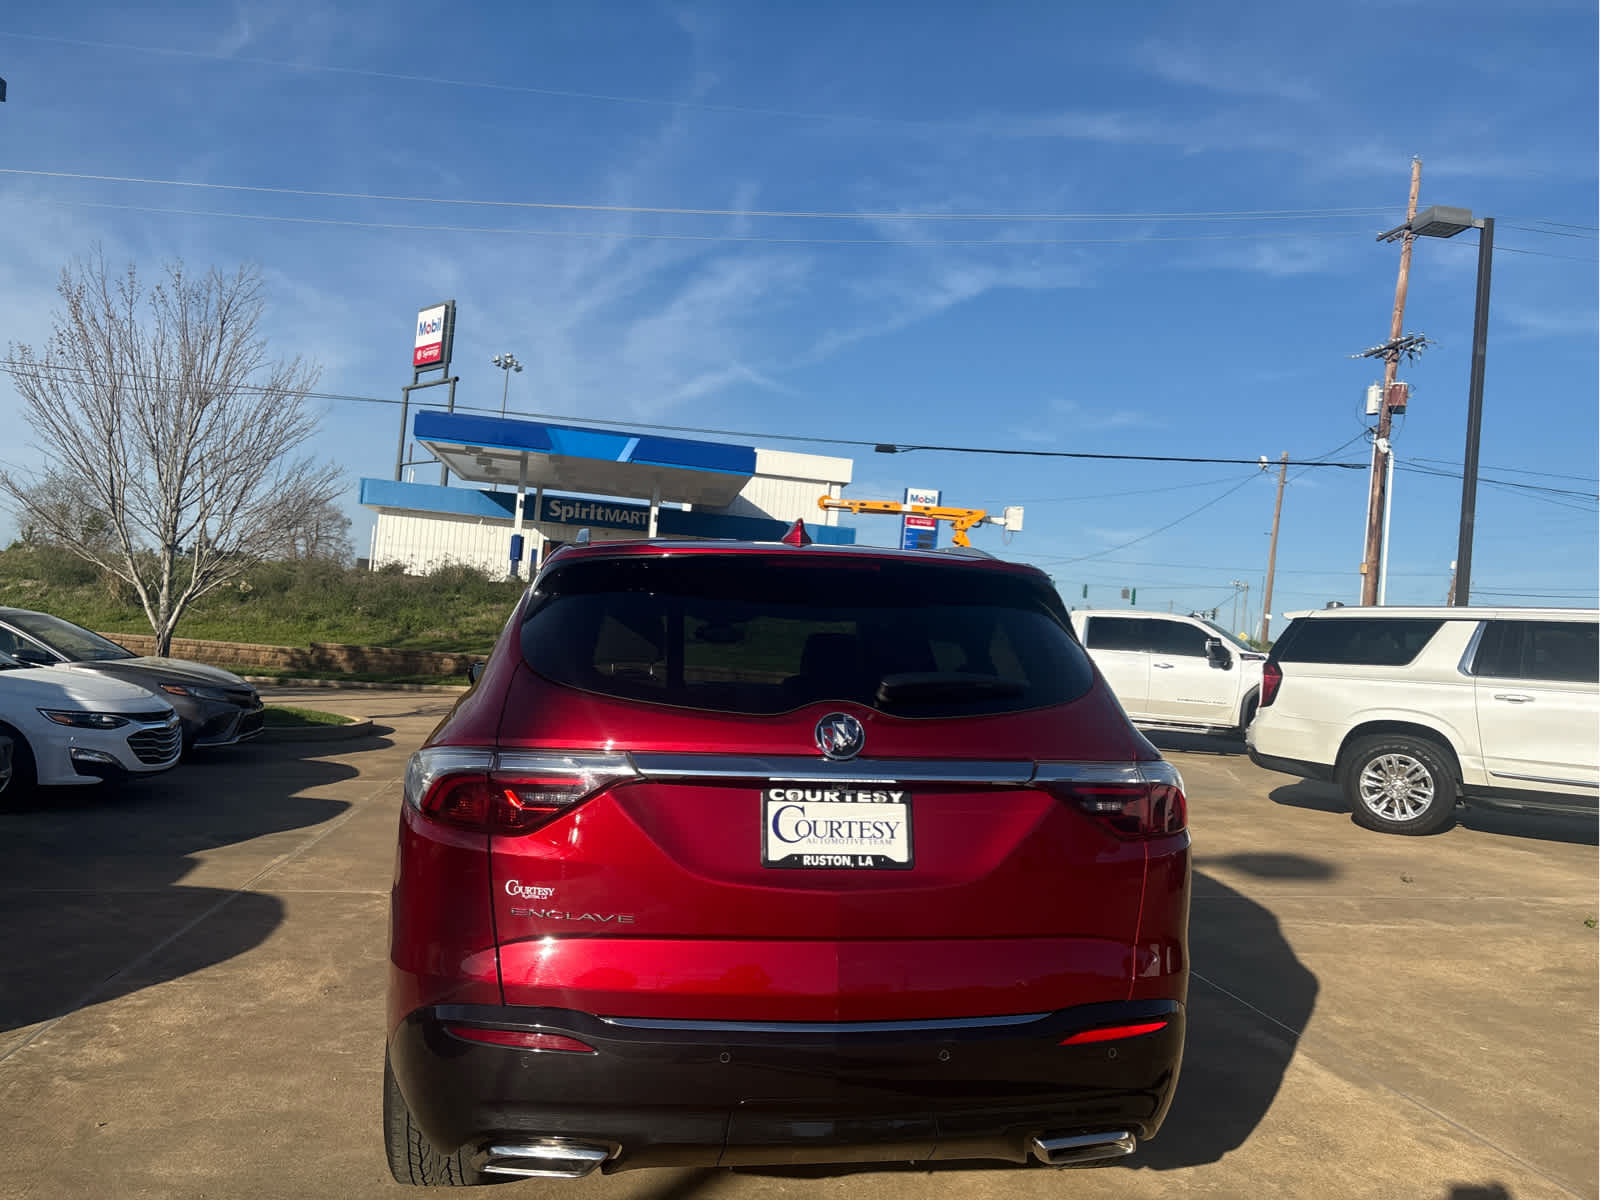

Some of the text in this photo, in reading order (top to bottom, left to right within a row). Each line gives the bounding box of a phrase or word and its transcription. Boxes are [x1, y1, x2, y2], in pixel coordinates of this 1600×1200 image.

[419, 317, 442, 336] Mobil
[911, 494, 936, 504] Mobil
[549, 500, 649, 525] SpiritMART
[769, 788, 904, 803] COURTESY
[806, 838, 865, 846] AUTOMOTIVE
[803, 855, 874, 867] RUSTON, LA
[511, 907, 635, 924] ENCLAVE
